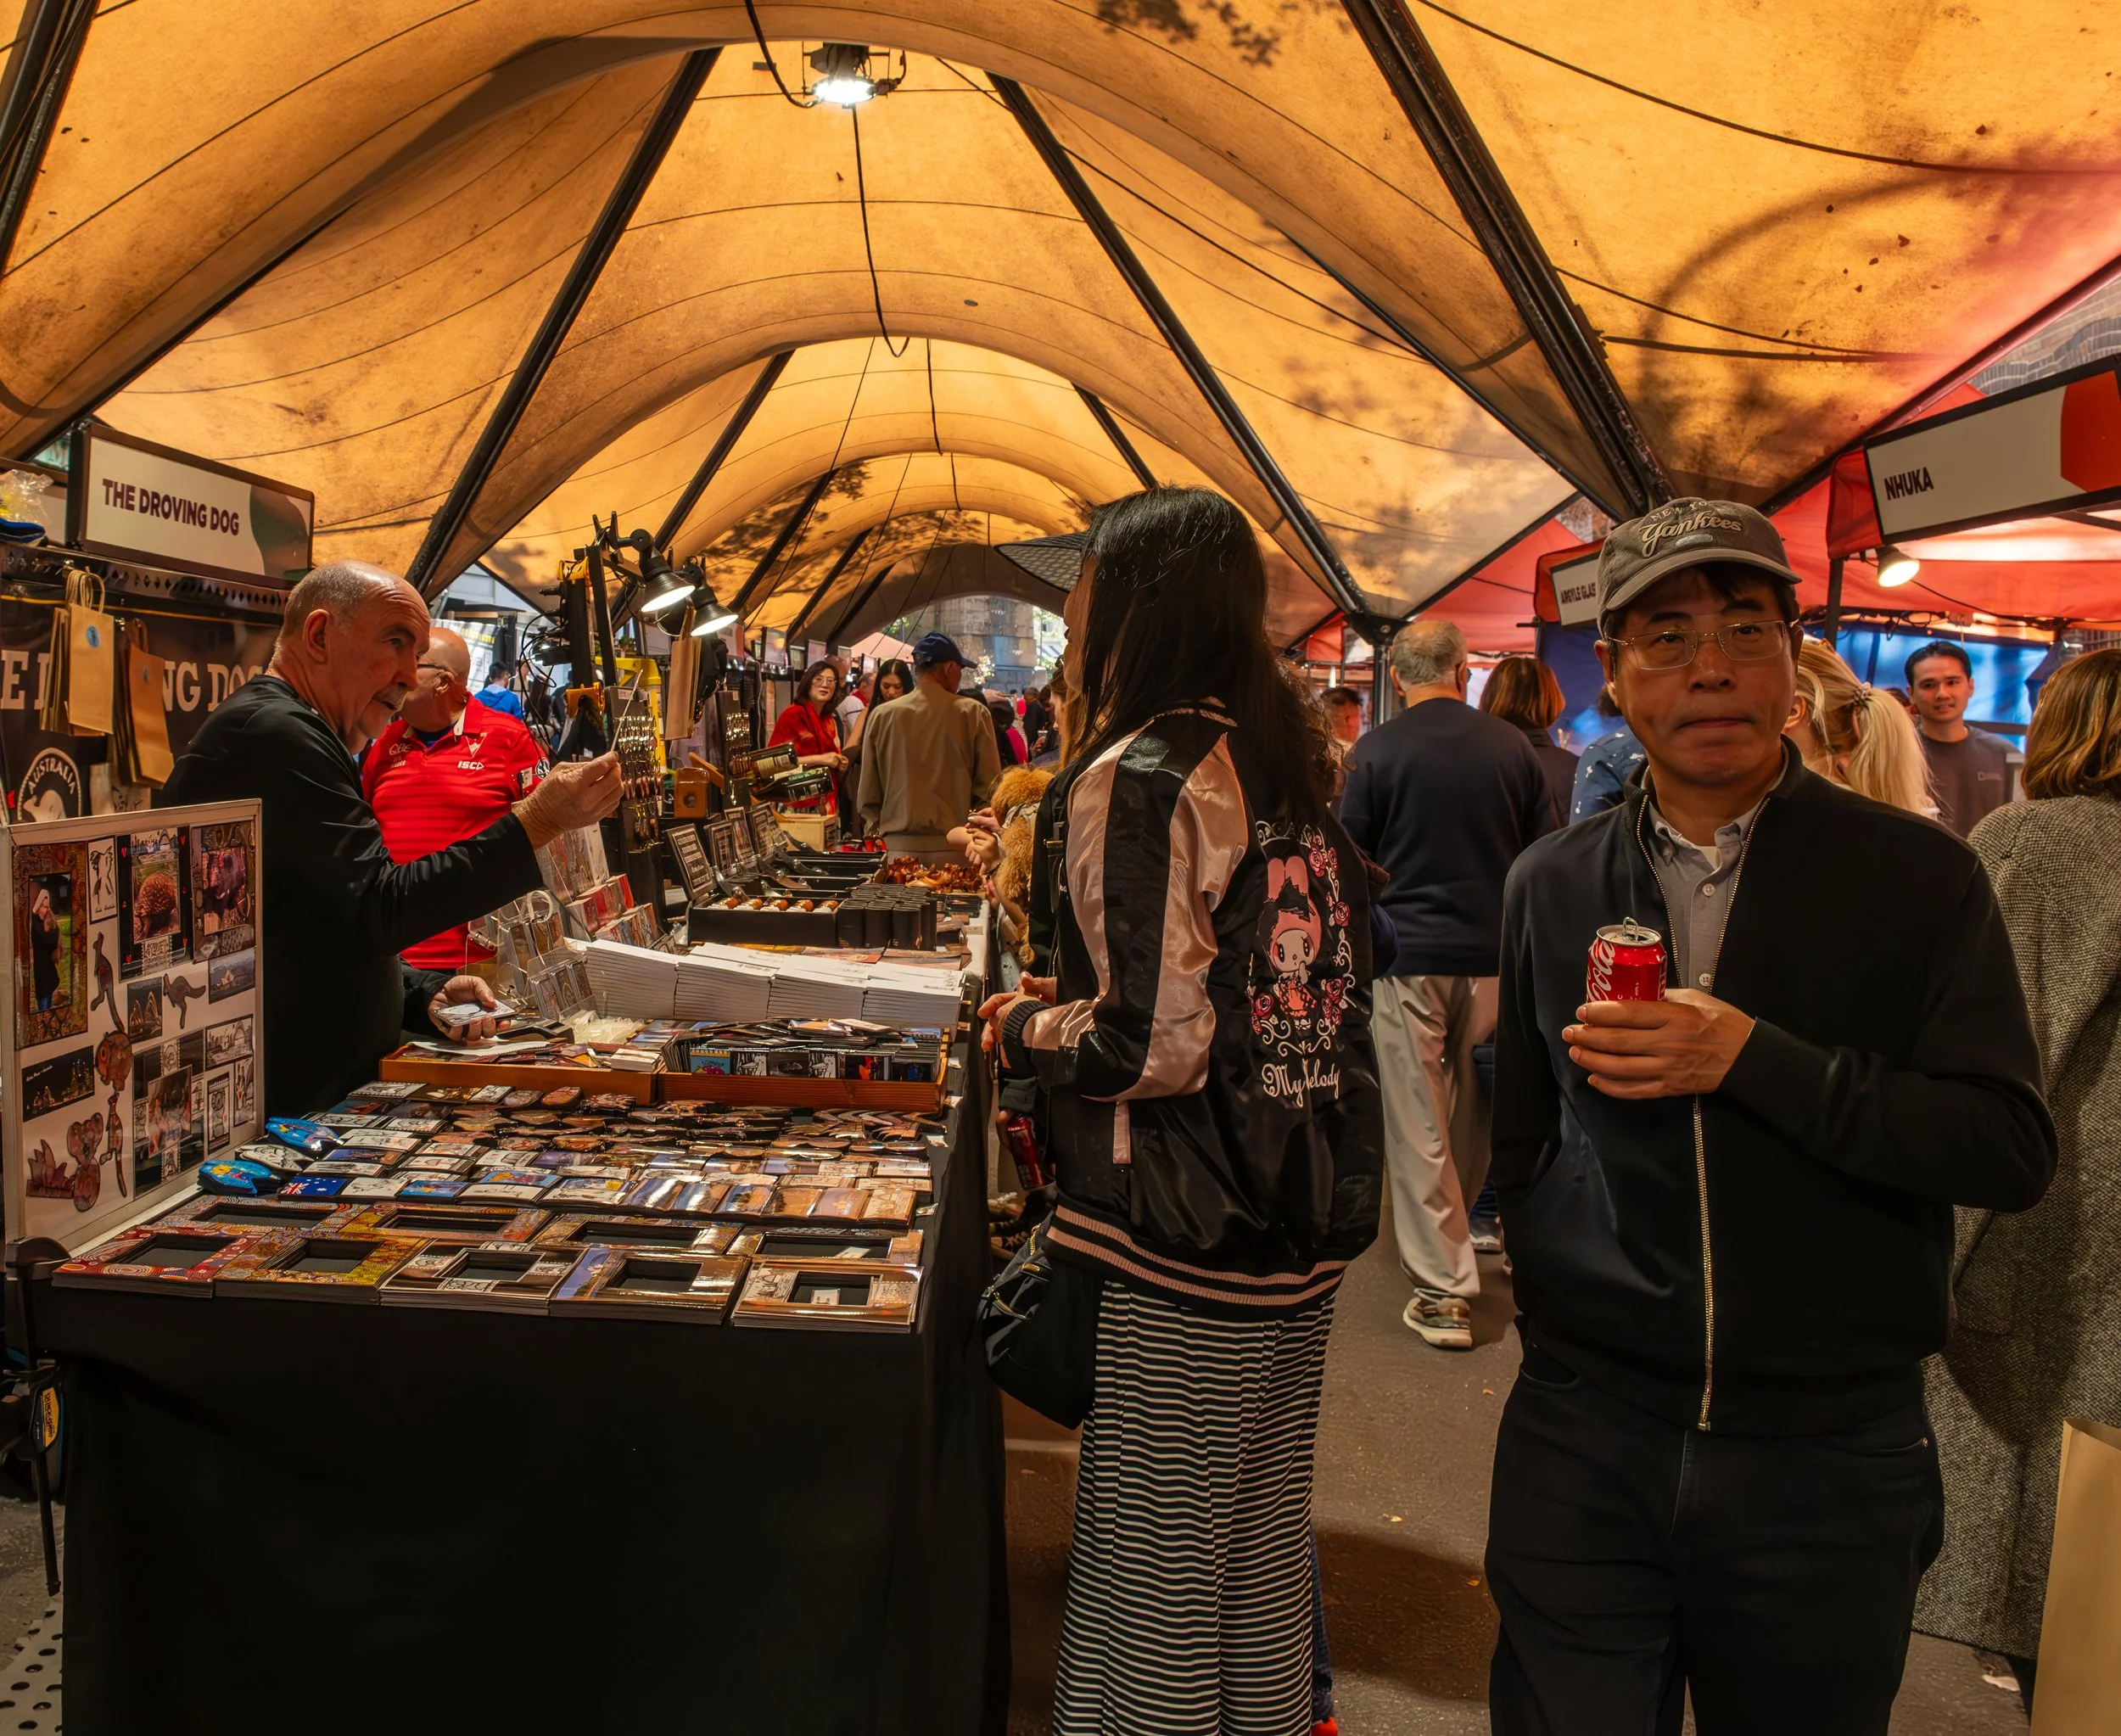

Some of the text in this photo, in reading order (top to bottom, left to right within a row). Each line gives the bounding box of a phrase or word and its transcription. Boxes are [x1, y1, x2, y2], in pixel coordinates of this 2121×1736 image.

[1884, 467, 1934, 501] NHUKA
[103, 479, 239, 535] THE DROVING DOG
[1639, 510, 1742, 557] Yankees
[389, 743, 411, 755] QBE
[28, 758, 76, 794] AUSTRALIA
[1262, 1063, 1306, 1107] My
